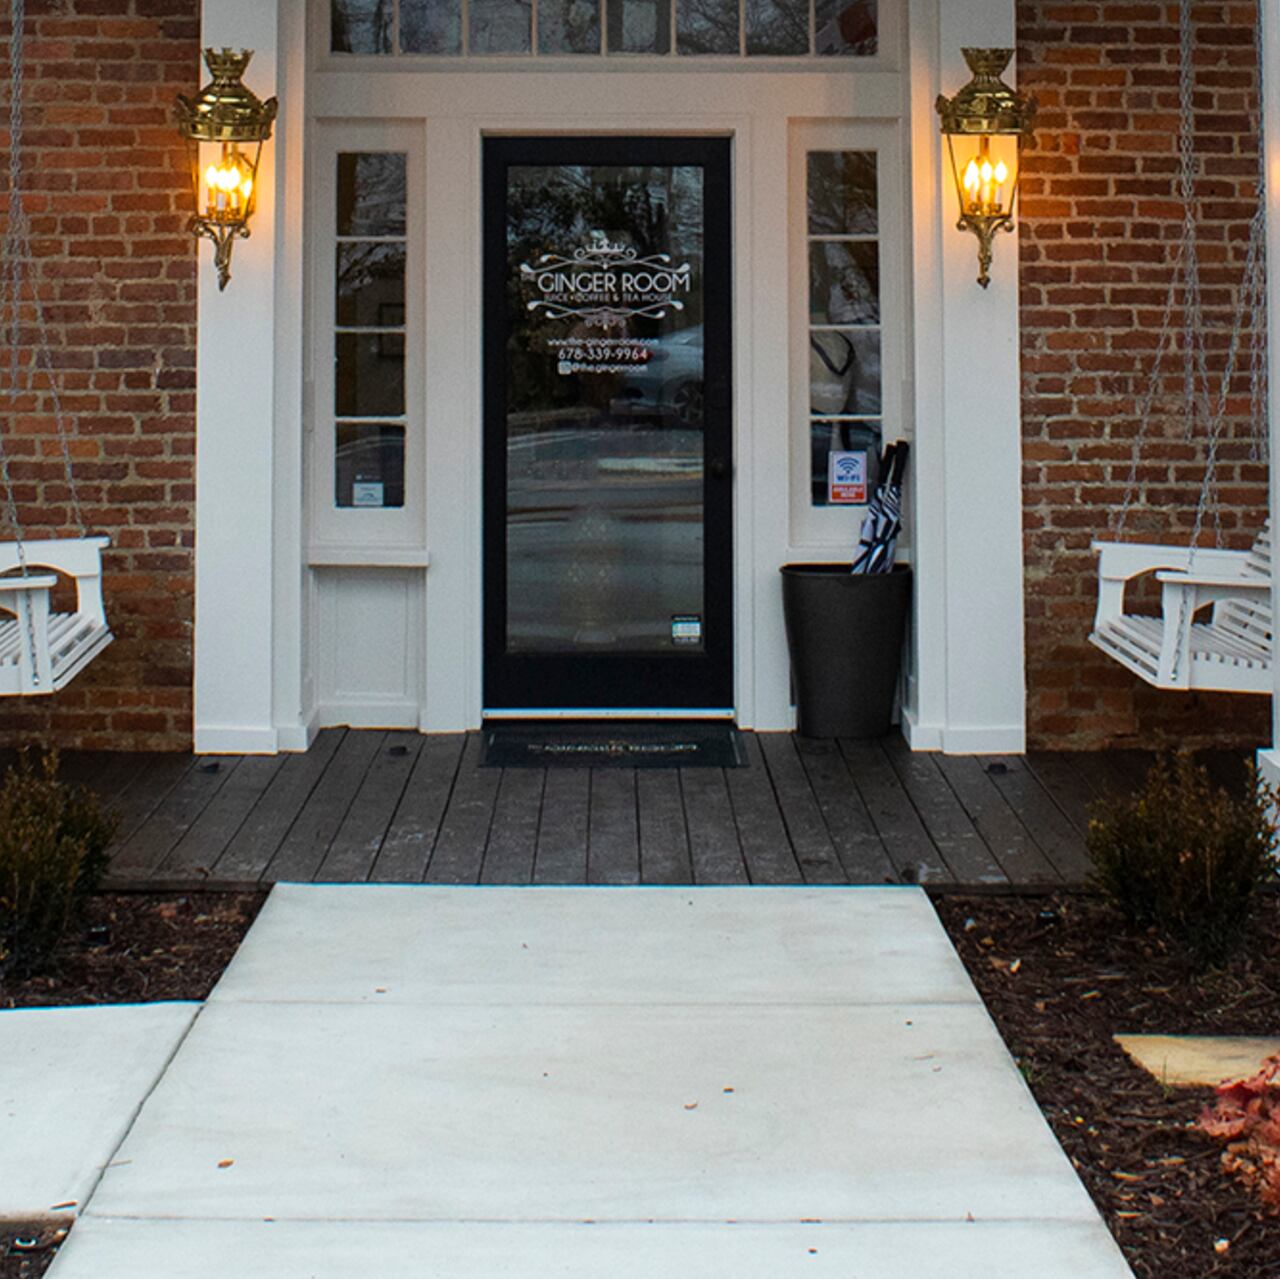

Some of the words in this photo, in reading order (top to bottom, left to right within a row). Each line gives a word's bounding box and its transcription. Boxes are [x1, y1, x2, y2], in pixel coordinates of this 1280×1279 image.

[537, 272, 617, 292] GINGER
[622, 272, 691, 292] ROOM
[622, 292, 641, 302] TEA
[558, 347, 648, 360] 678-339-9964
